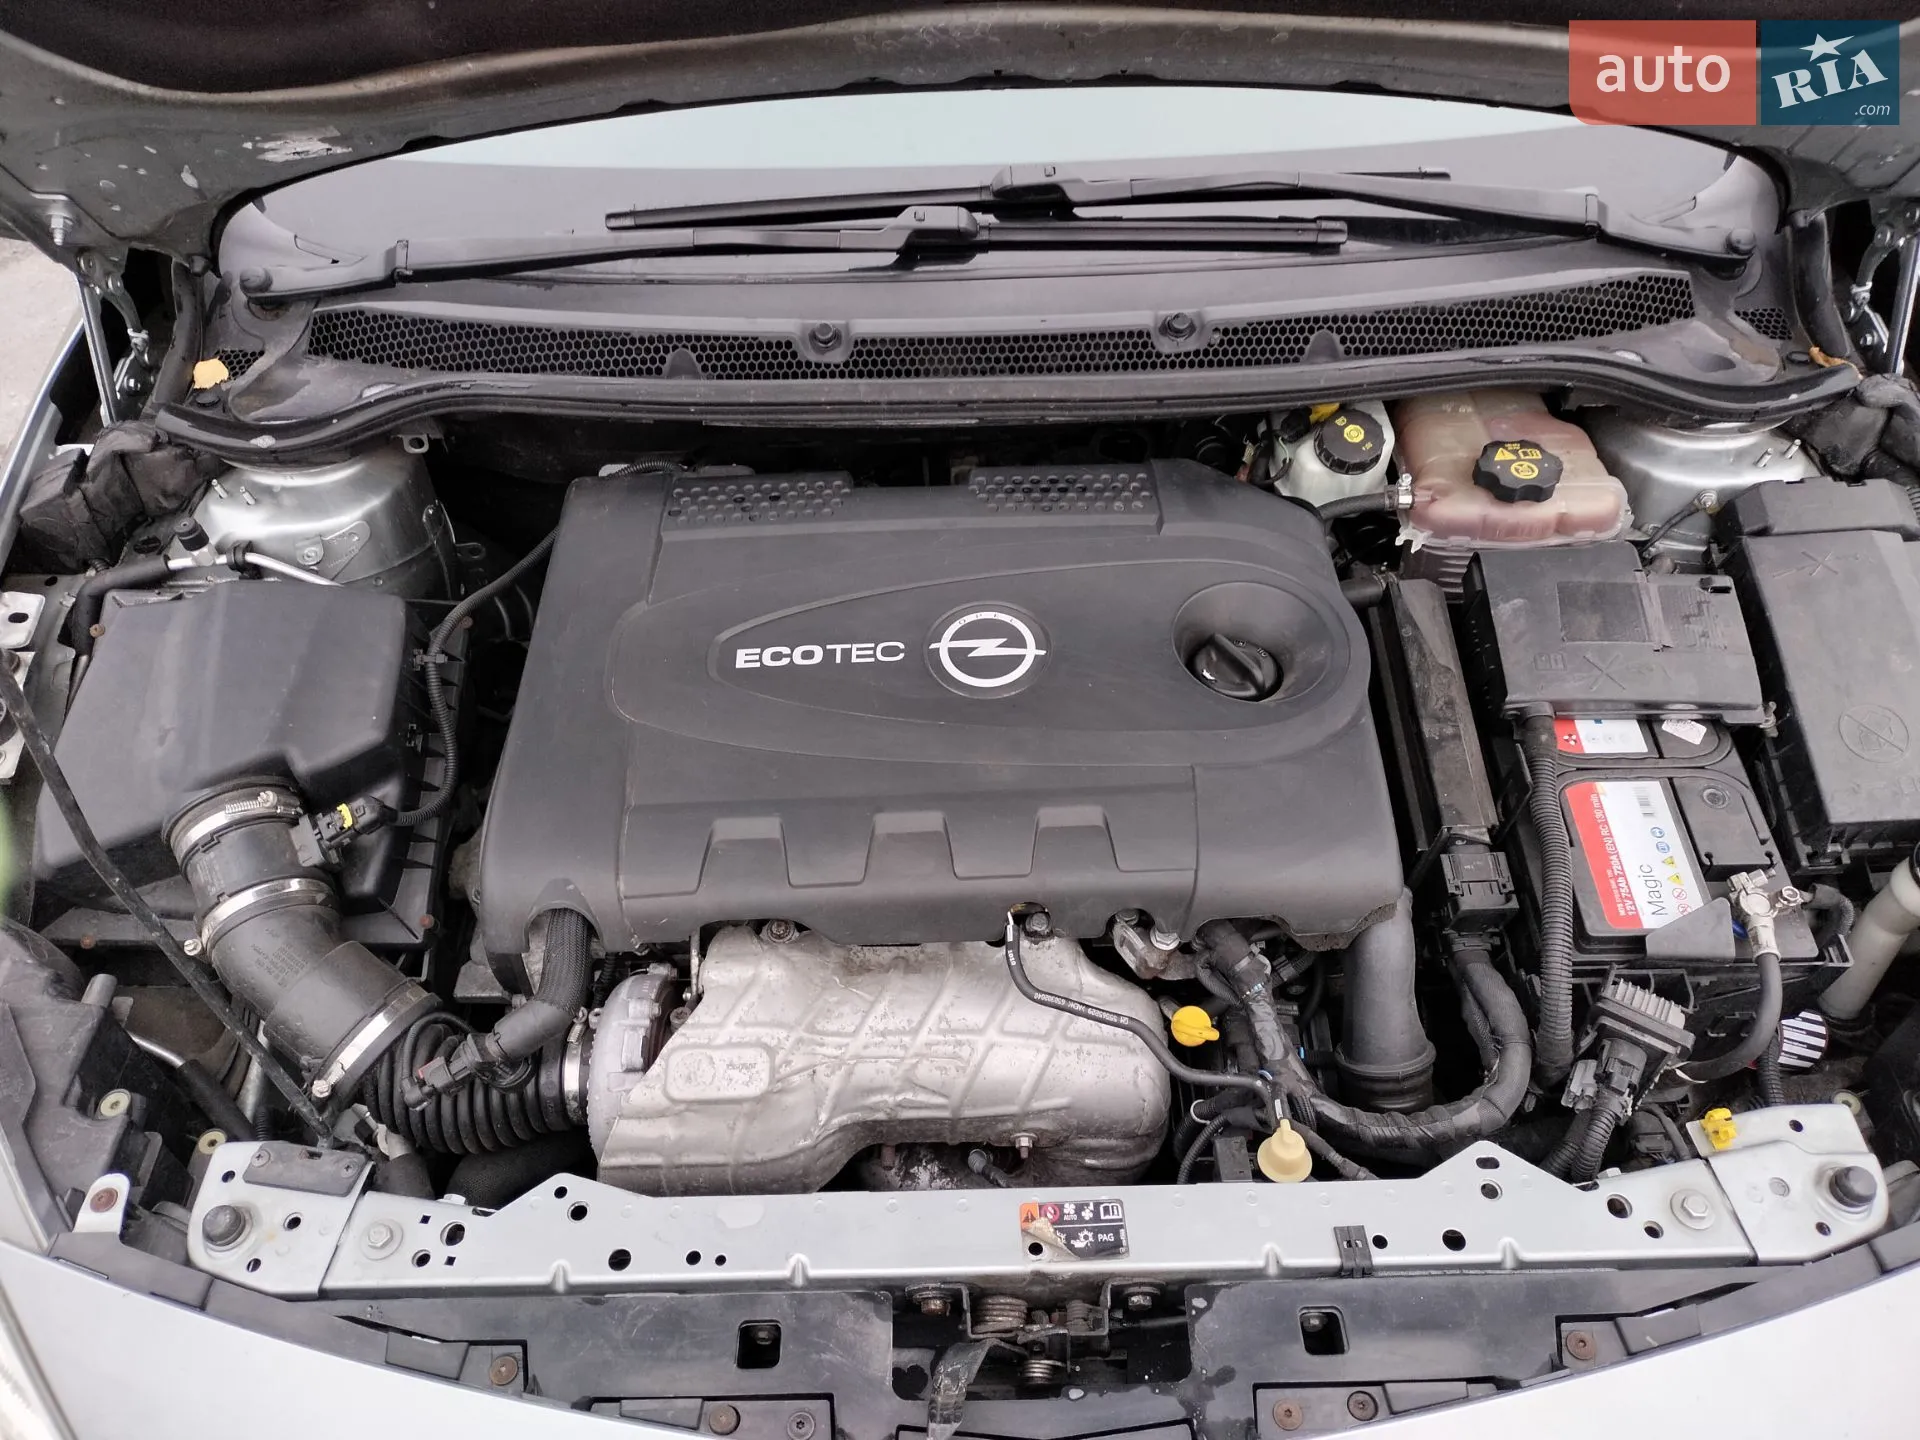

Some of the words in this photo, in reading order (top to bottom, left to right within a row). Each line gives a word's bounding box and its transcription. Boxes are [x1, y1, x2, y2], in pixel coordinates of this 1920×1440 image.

[735, 641, 905, 669] ECOTEC
[1617, 877, 1630, 896] 75Ah
[1637, 864, 1669, 915] Magic
[1624, 899, 1636, 915] 12V
[1098, 1233, 1115, 1242] PAG
